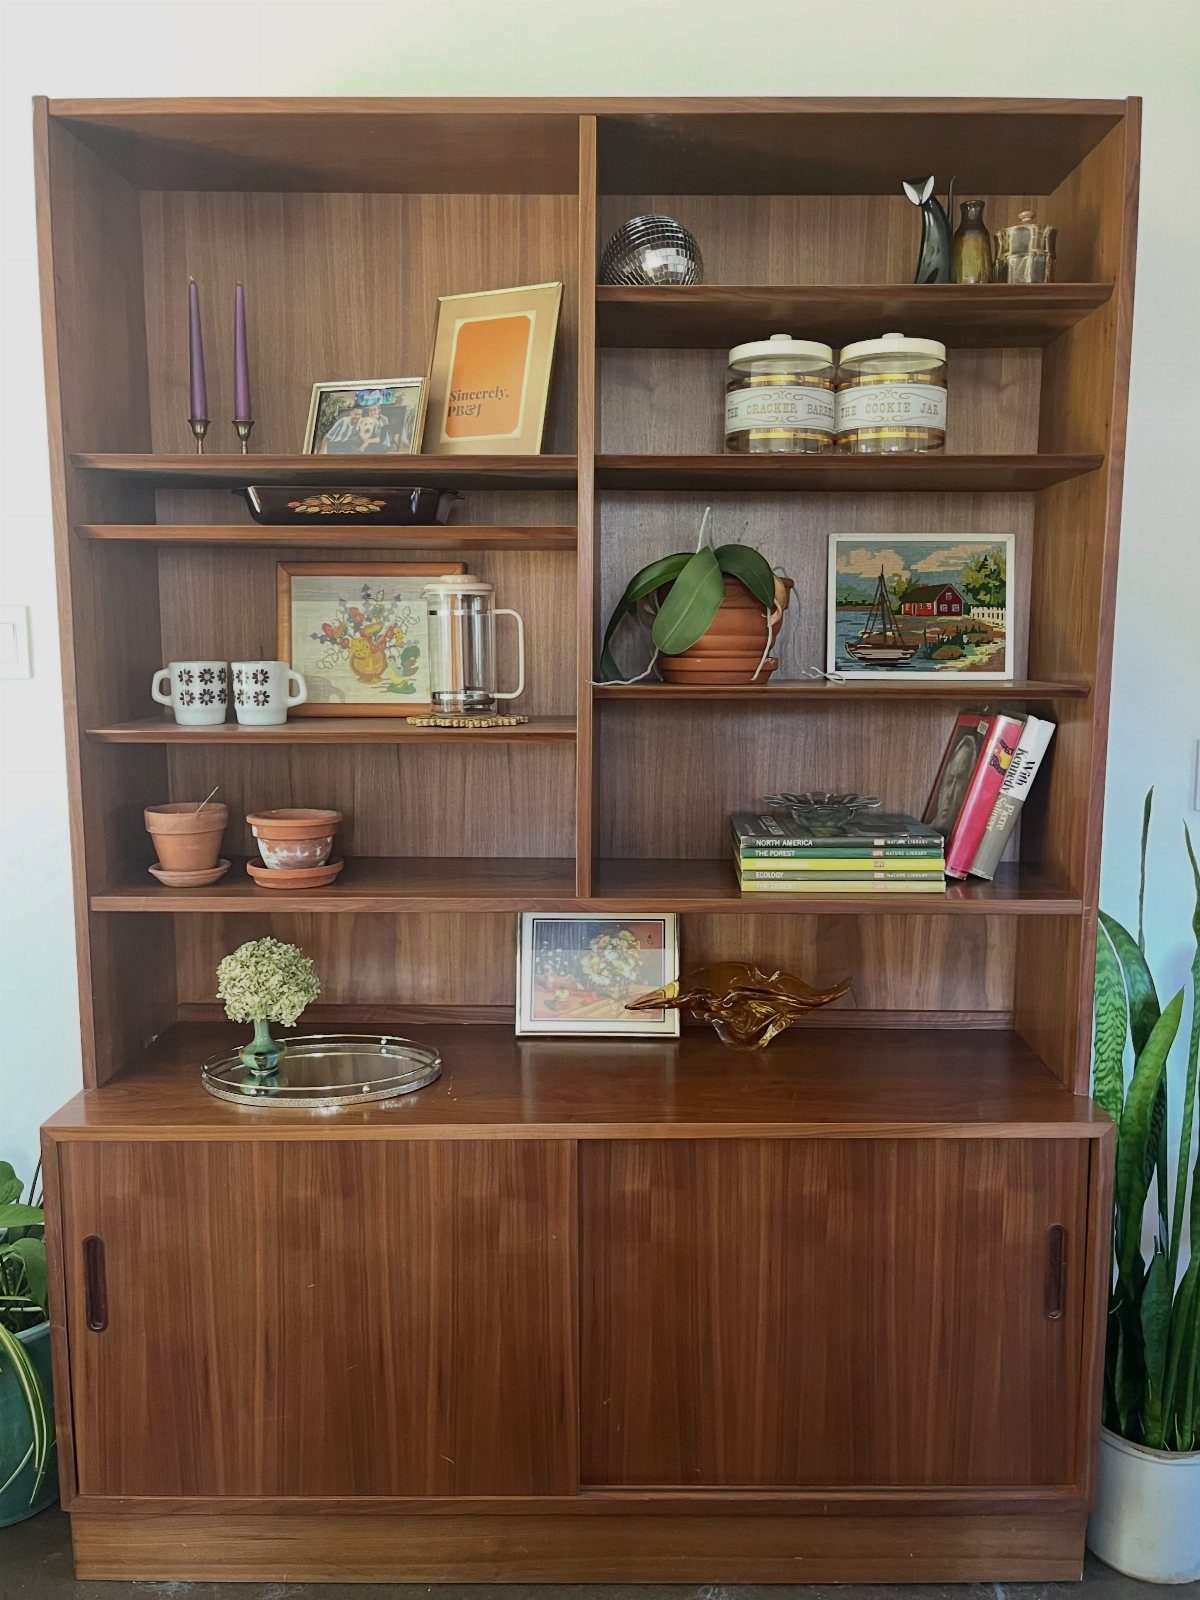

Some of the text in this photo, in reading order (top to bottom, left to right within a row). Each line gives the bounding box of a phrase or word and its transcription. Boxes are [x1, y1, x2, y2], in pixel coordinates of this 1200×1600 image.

[447, 403, 482, 418] PB&J
[727, 407, 739, 420] THE
[746, 402, 798, 415] CRACKER
[840, 401, 939, 419] THE COOKIE JAR
[1000, 747, 1030, 794] Kennedy
[1015, 761, 1036, 786] With
[996, 802, 1016, 832] Pierre
[755, 839, 781, 847] NORTH
[755, 849, 769, 857] THE
[769, 849, 796, 857] FOREST
[755, 871, 784, 879] ECOLOGY
